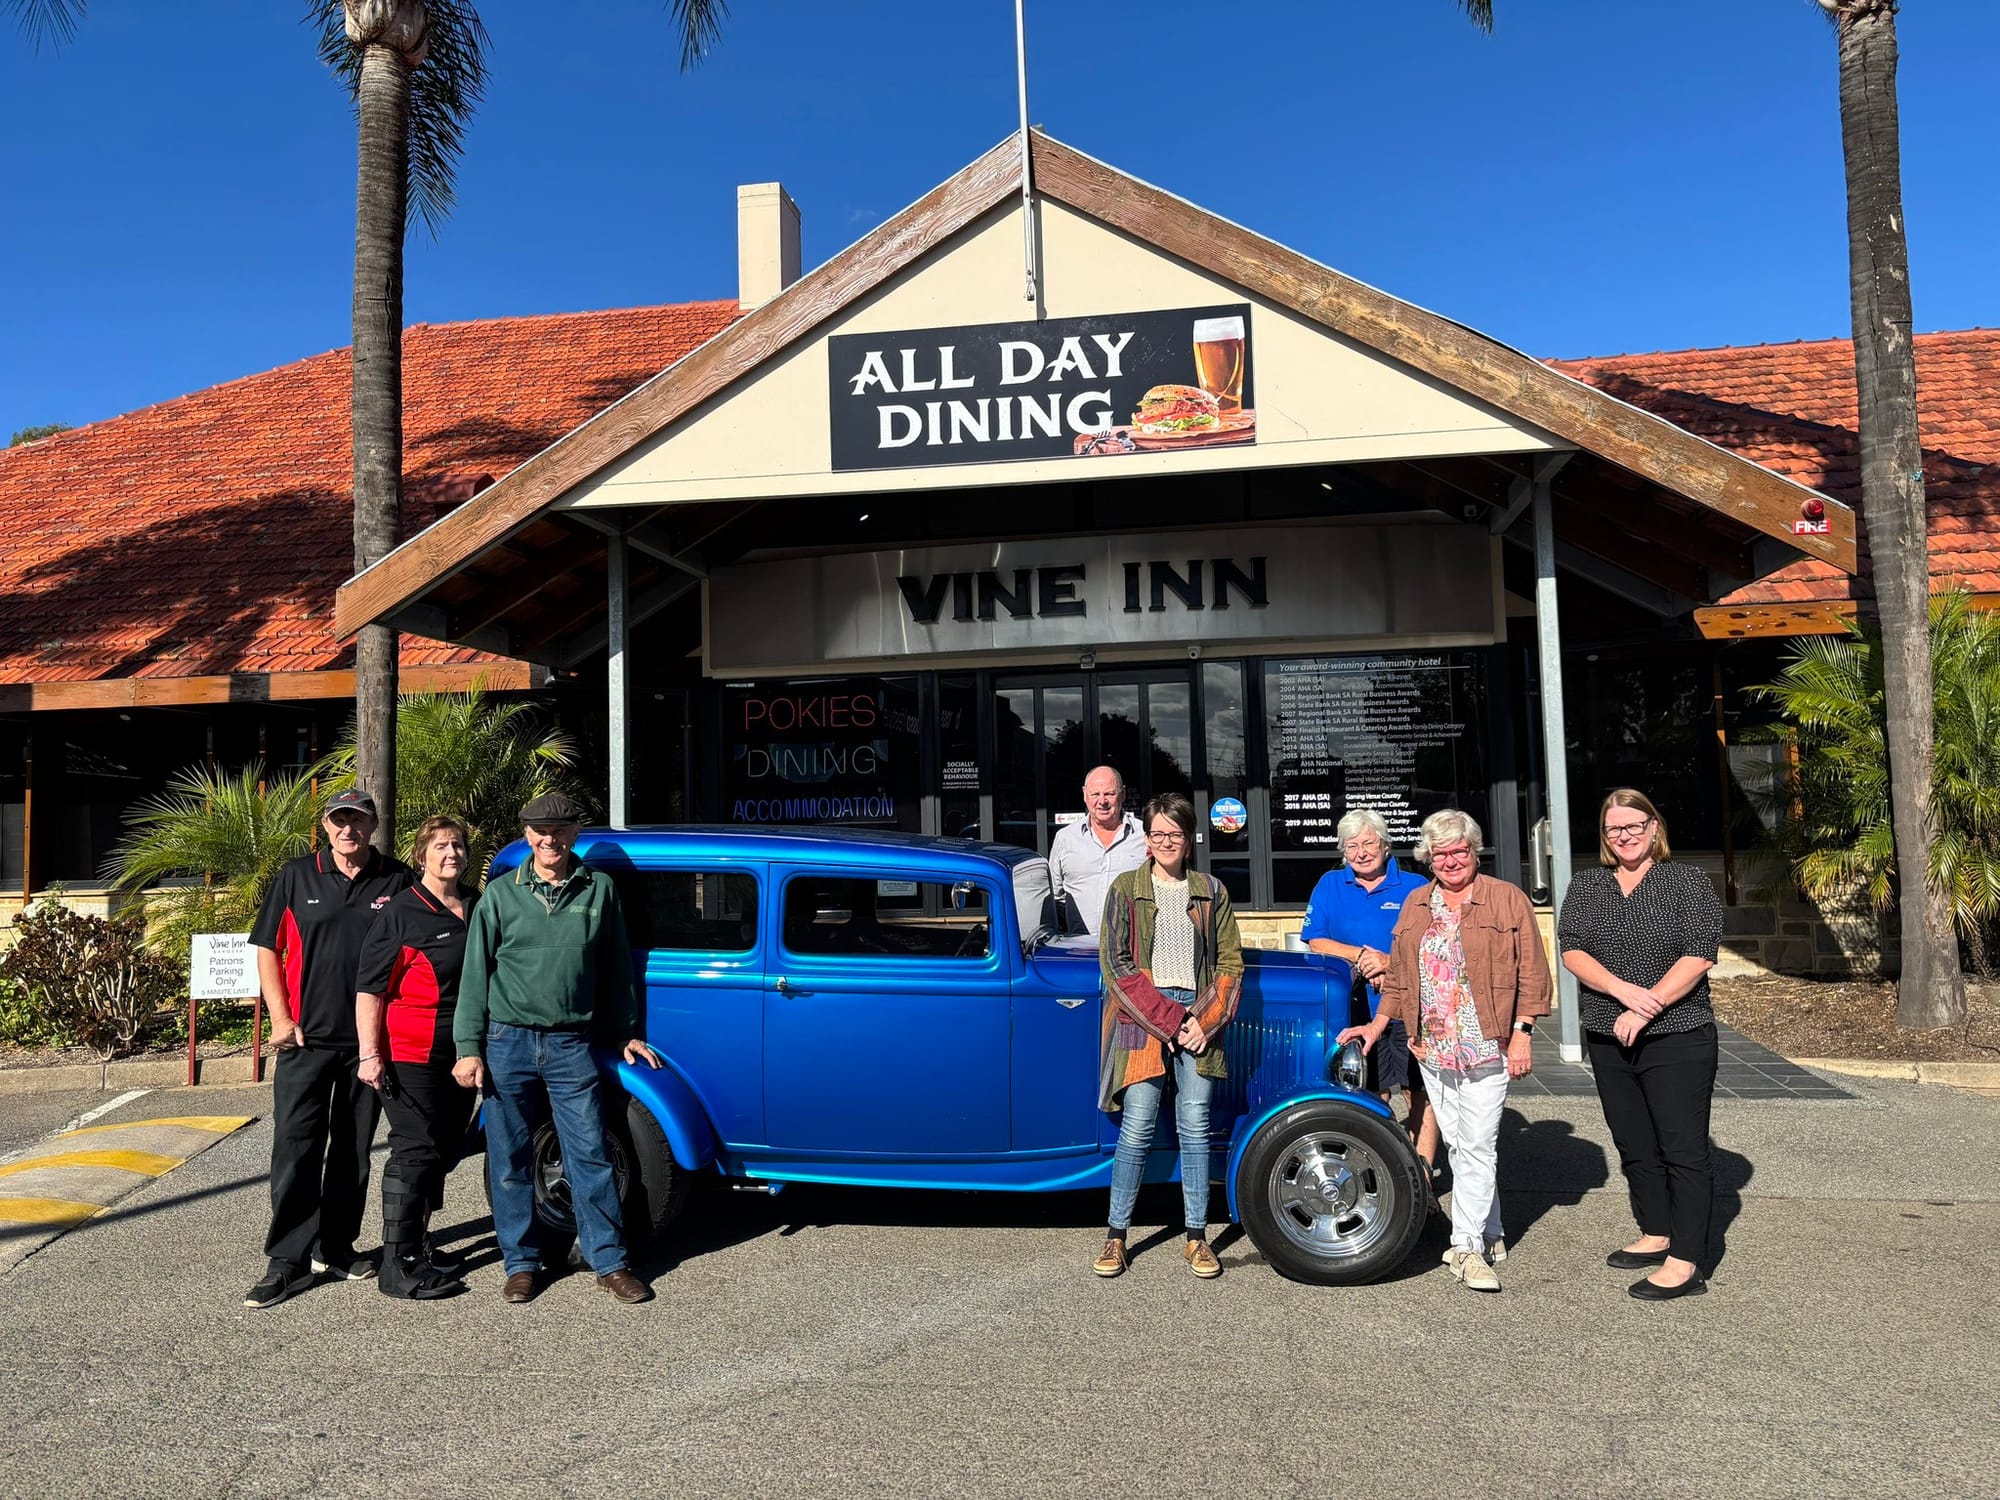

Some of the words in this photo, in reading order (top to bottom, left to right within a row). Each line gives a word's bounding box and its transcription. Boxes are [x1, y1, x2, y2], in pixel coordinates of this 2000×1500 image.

[848, 345, 975, 396] ALL
[998, 332, 1136, 386] DAY
[876, 389, 1114, 449] DINING
[1795, 520, 1828, 533] FIRE
[896, 563, 1087, 623] VINE
[1122, 556, 1270, 613] INN
[1280, 663, 1299, 672] Your
[1301, 661, 1366, 671] award-winning
[1367, 658, 1417, 668] community
[1418, 657, 1442, 666] hotel
[1298, 693, 1325, 702] Regional
[745, 695, 876, 730] POKIES
[1298, 710, 1325, 718] Regional
[1361, 724, 1388, 732] Catering
[747, 745, 876, 777] DINING
[1344, 768, 1373, 776] Community
[1345, 776, 1364, 784] Gaming
[1345, 793, 1365, 801] Gaming
[733, 796, 893, 821] ACCOMMODATION
[209, 936, 230, 949] Vine
[231, 937, 246, 949] Inn
[209, 957, 244, 965] Patrons
[209, 967, 243, 976] Parking
[215, 977, 237, 987] Only
